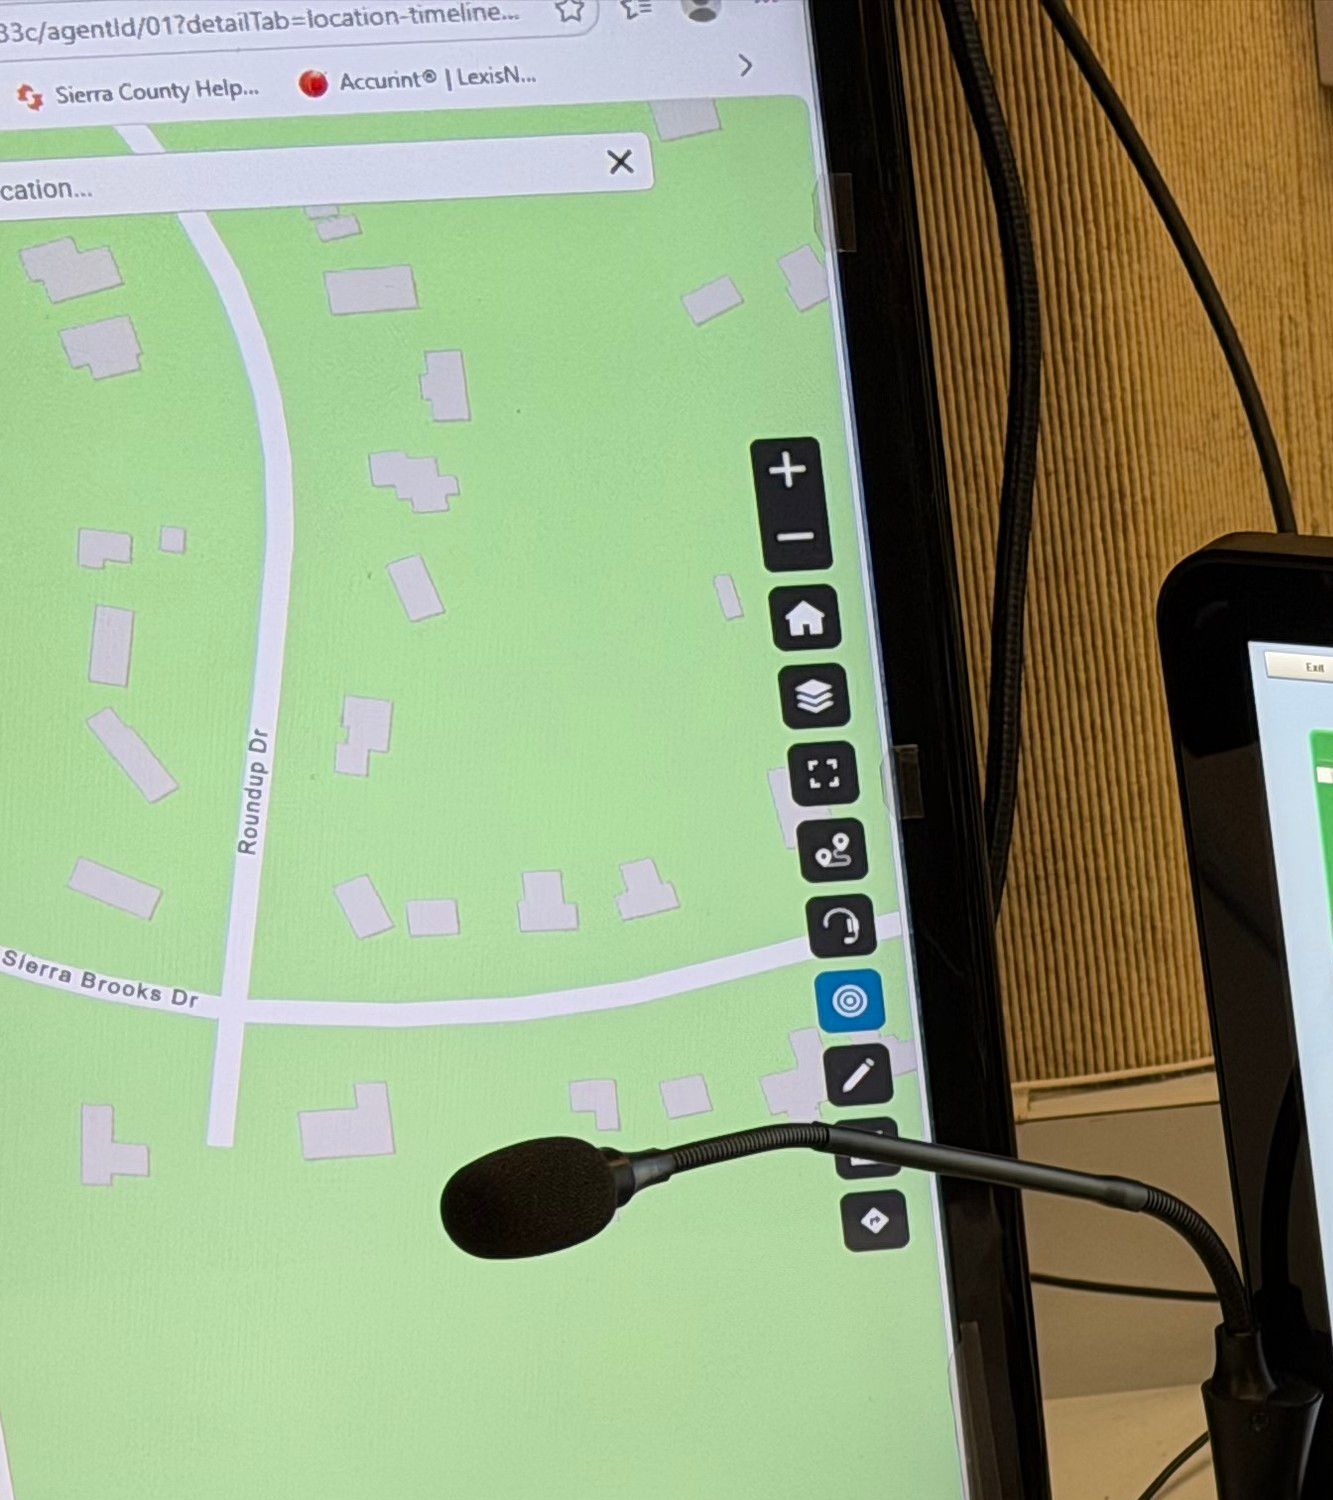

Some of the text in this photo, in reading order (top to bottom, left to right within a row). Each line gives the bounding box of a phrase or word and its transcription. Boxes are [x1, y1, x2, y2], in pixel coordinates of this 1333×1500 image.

[55, 78, 260, 105] Sierra County Help...
[1305, 661, 1326, 674] Exit
[249, 728, 268, 753] Dr
[237, 761, 269, 856] Roundup
[1, 949, 199, 1009] Sierra Brooks Dr
